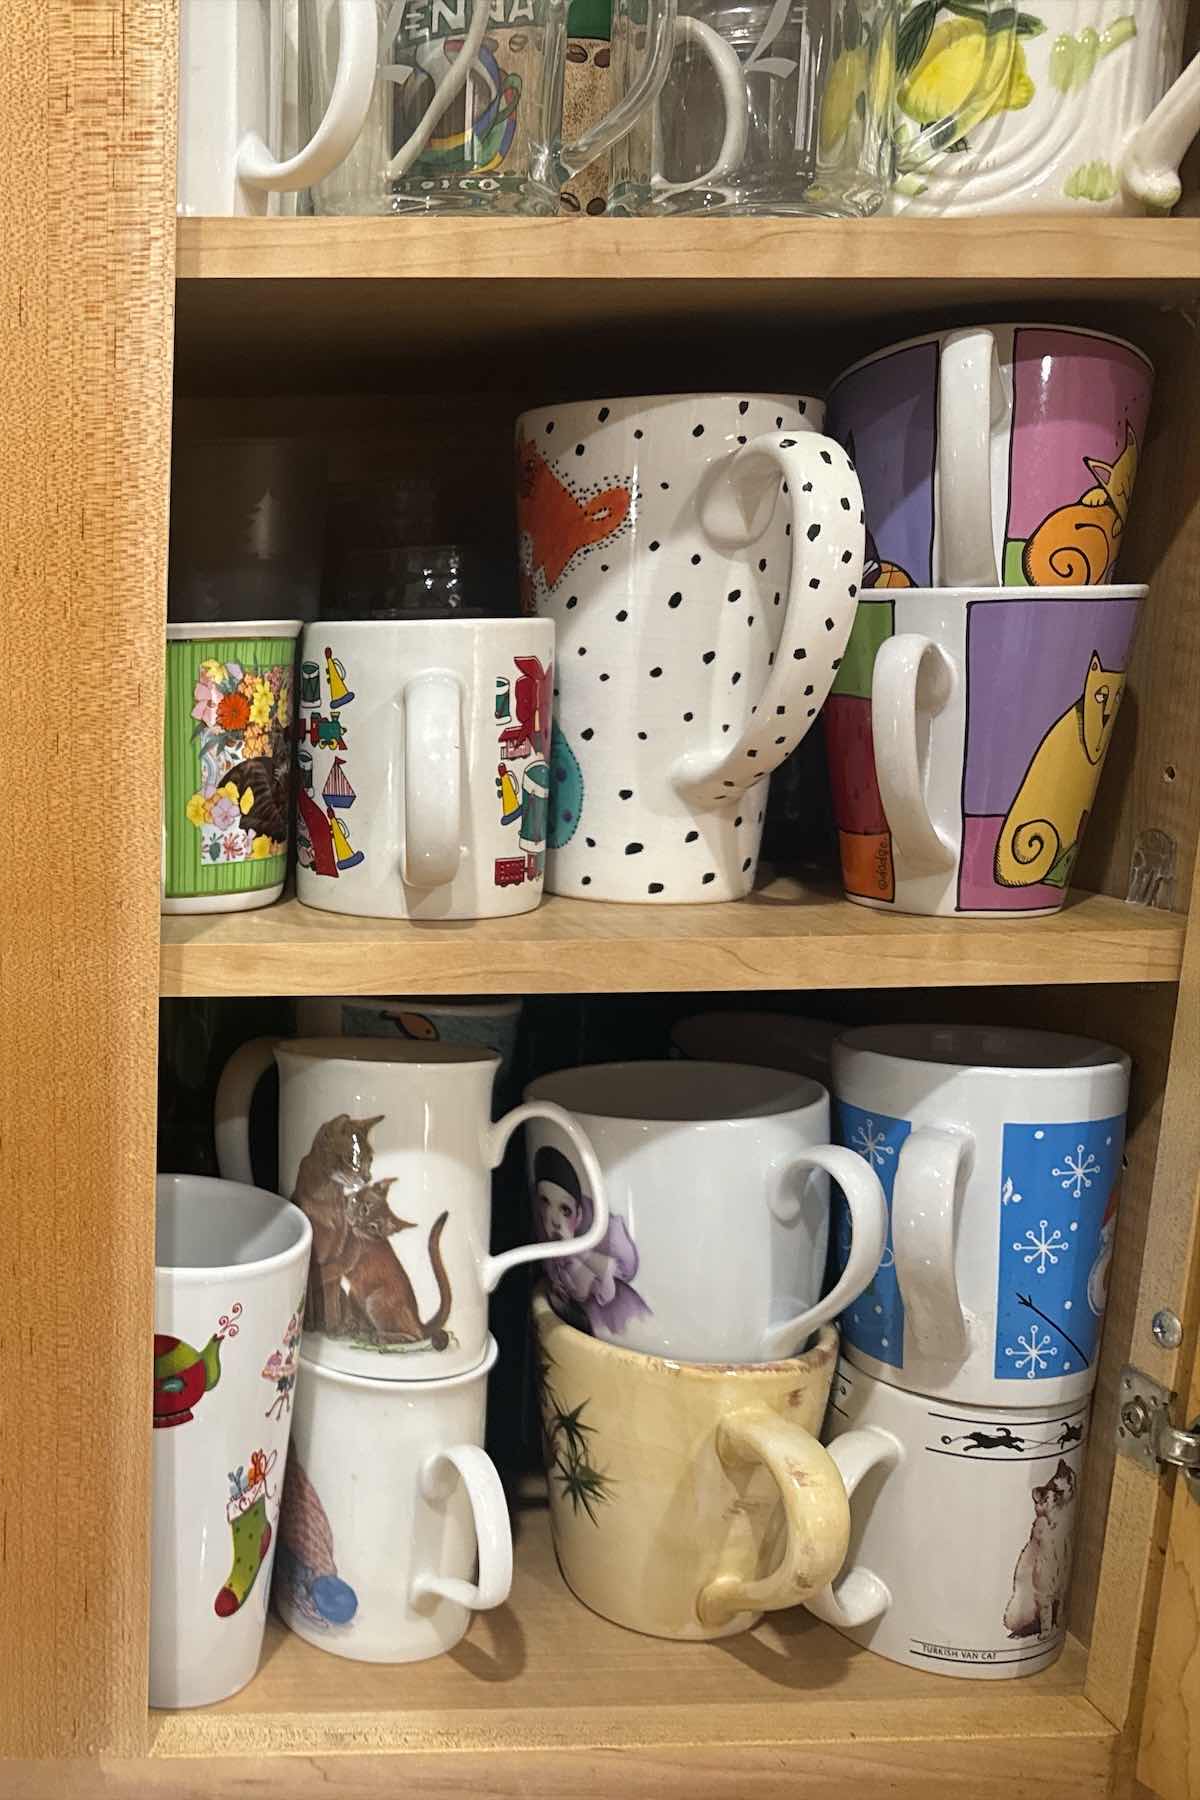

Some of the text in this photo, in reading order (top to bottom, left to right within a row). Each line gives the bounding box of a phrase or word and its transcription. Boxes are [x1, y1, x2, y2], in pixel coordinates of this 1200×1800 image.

[922, 1643, 997, 1660] TURKISH VAN CAT
